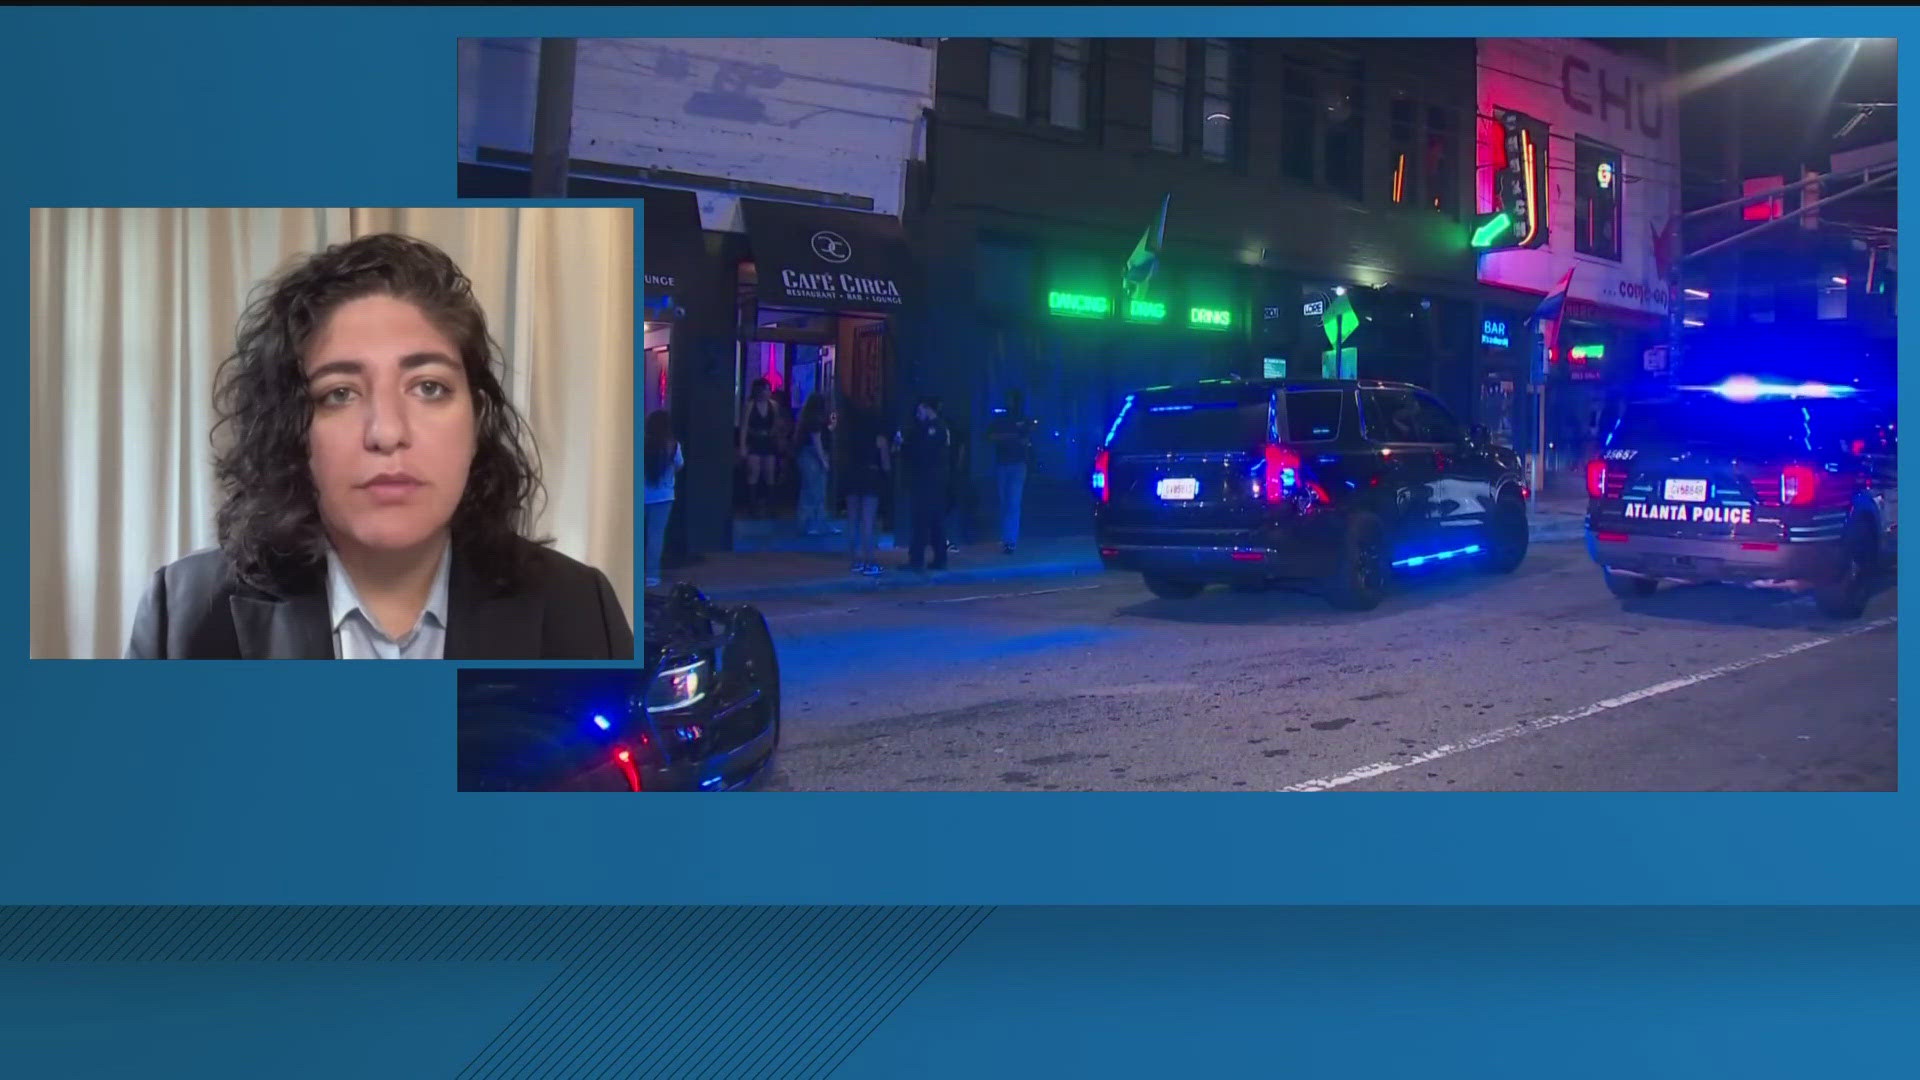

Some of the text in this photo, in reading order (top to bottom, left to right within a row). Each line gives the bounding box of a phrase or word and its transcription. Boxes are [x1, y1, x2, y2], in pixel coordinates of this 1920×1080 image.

[1561, 55, 1664, 140] CHU
[840, 273, 899, 297] CIRCA
[786, 288, 903, 305] RESTAURANT BAR LOUNGE
[1191, 307, 1231, 326] DRINKS
[1484, 320, 1506, 336] BAR
[1624, 502, 1752, 524] ATLANTA POLICE
